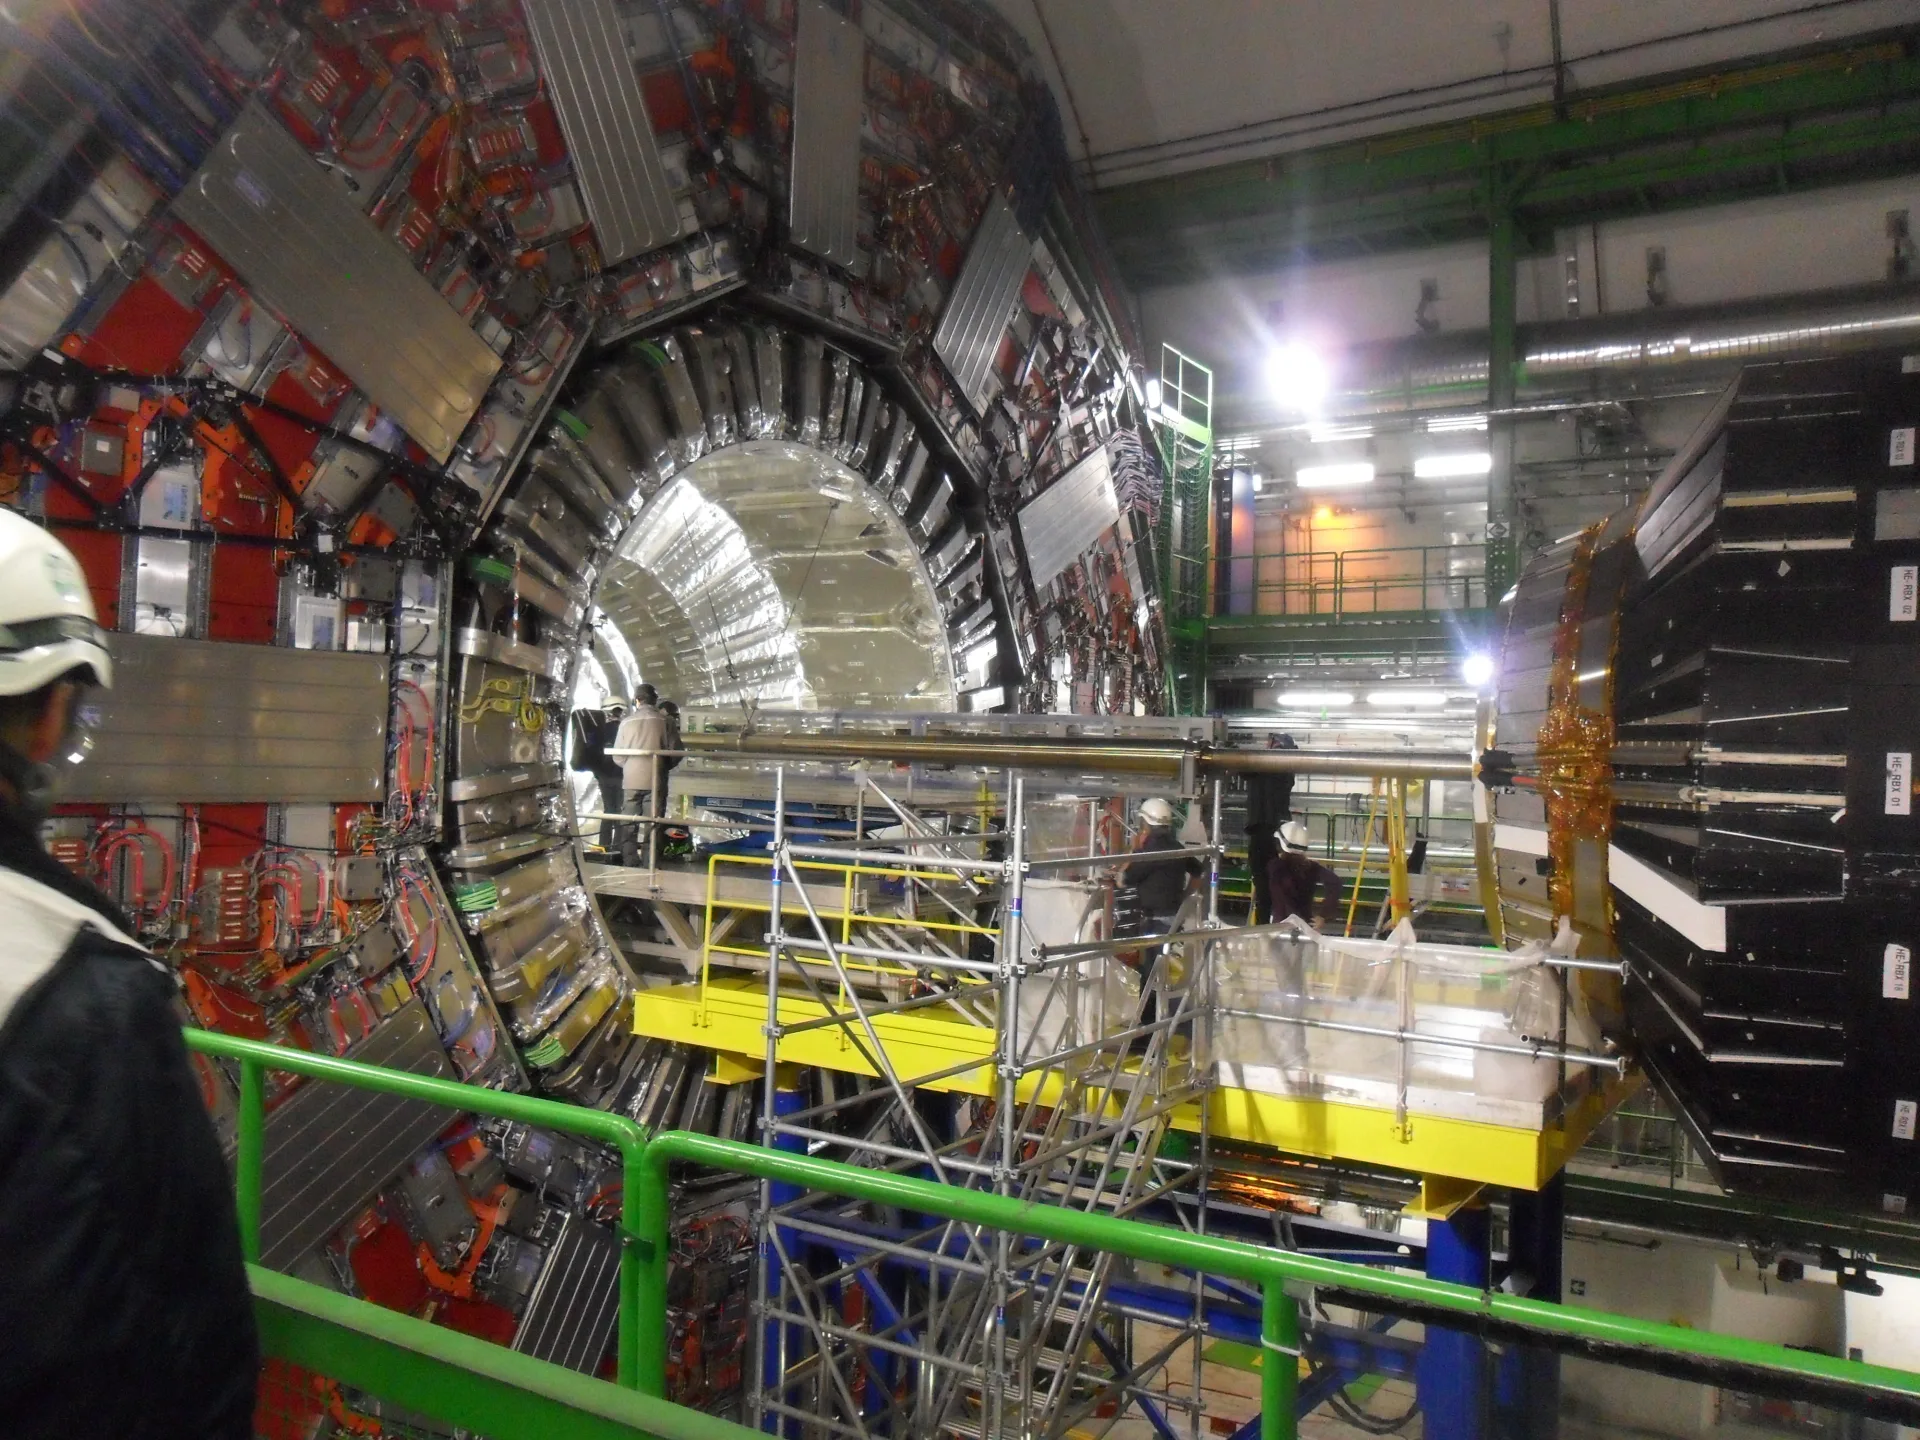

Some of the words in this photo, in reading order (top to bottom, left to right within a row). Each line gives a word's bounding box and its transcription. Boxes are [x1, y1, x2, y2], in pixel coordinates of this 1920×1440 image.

[1903, 584, 1913, 601] RBX
[1902, 604, 1912, 615] 02
[1891, 774, 1902, 793] RBX
[1891, 797, 1901, 807] 01
[1895, 964, 1905, 981] RBX
